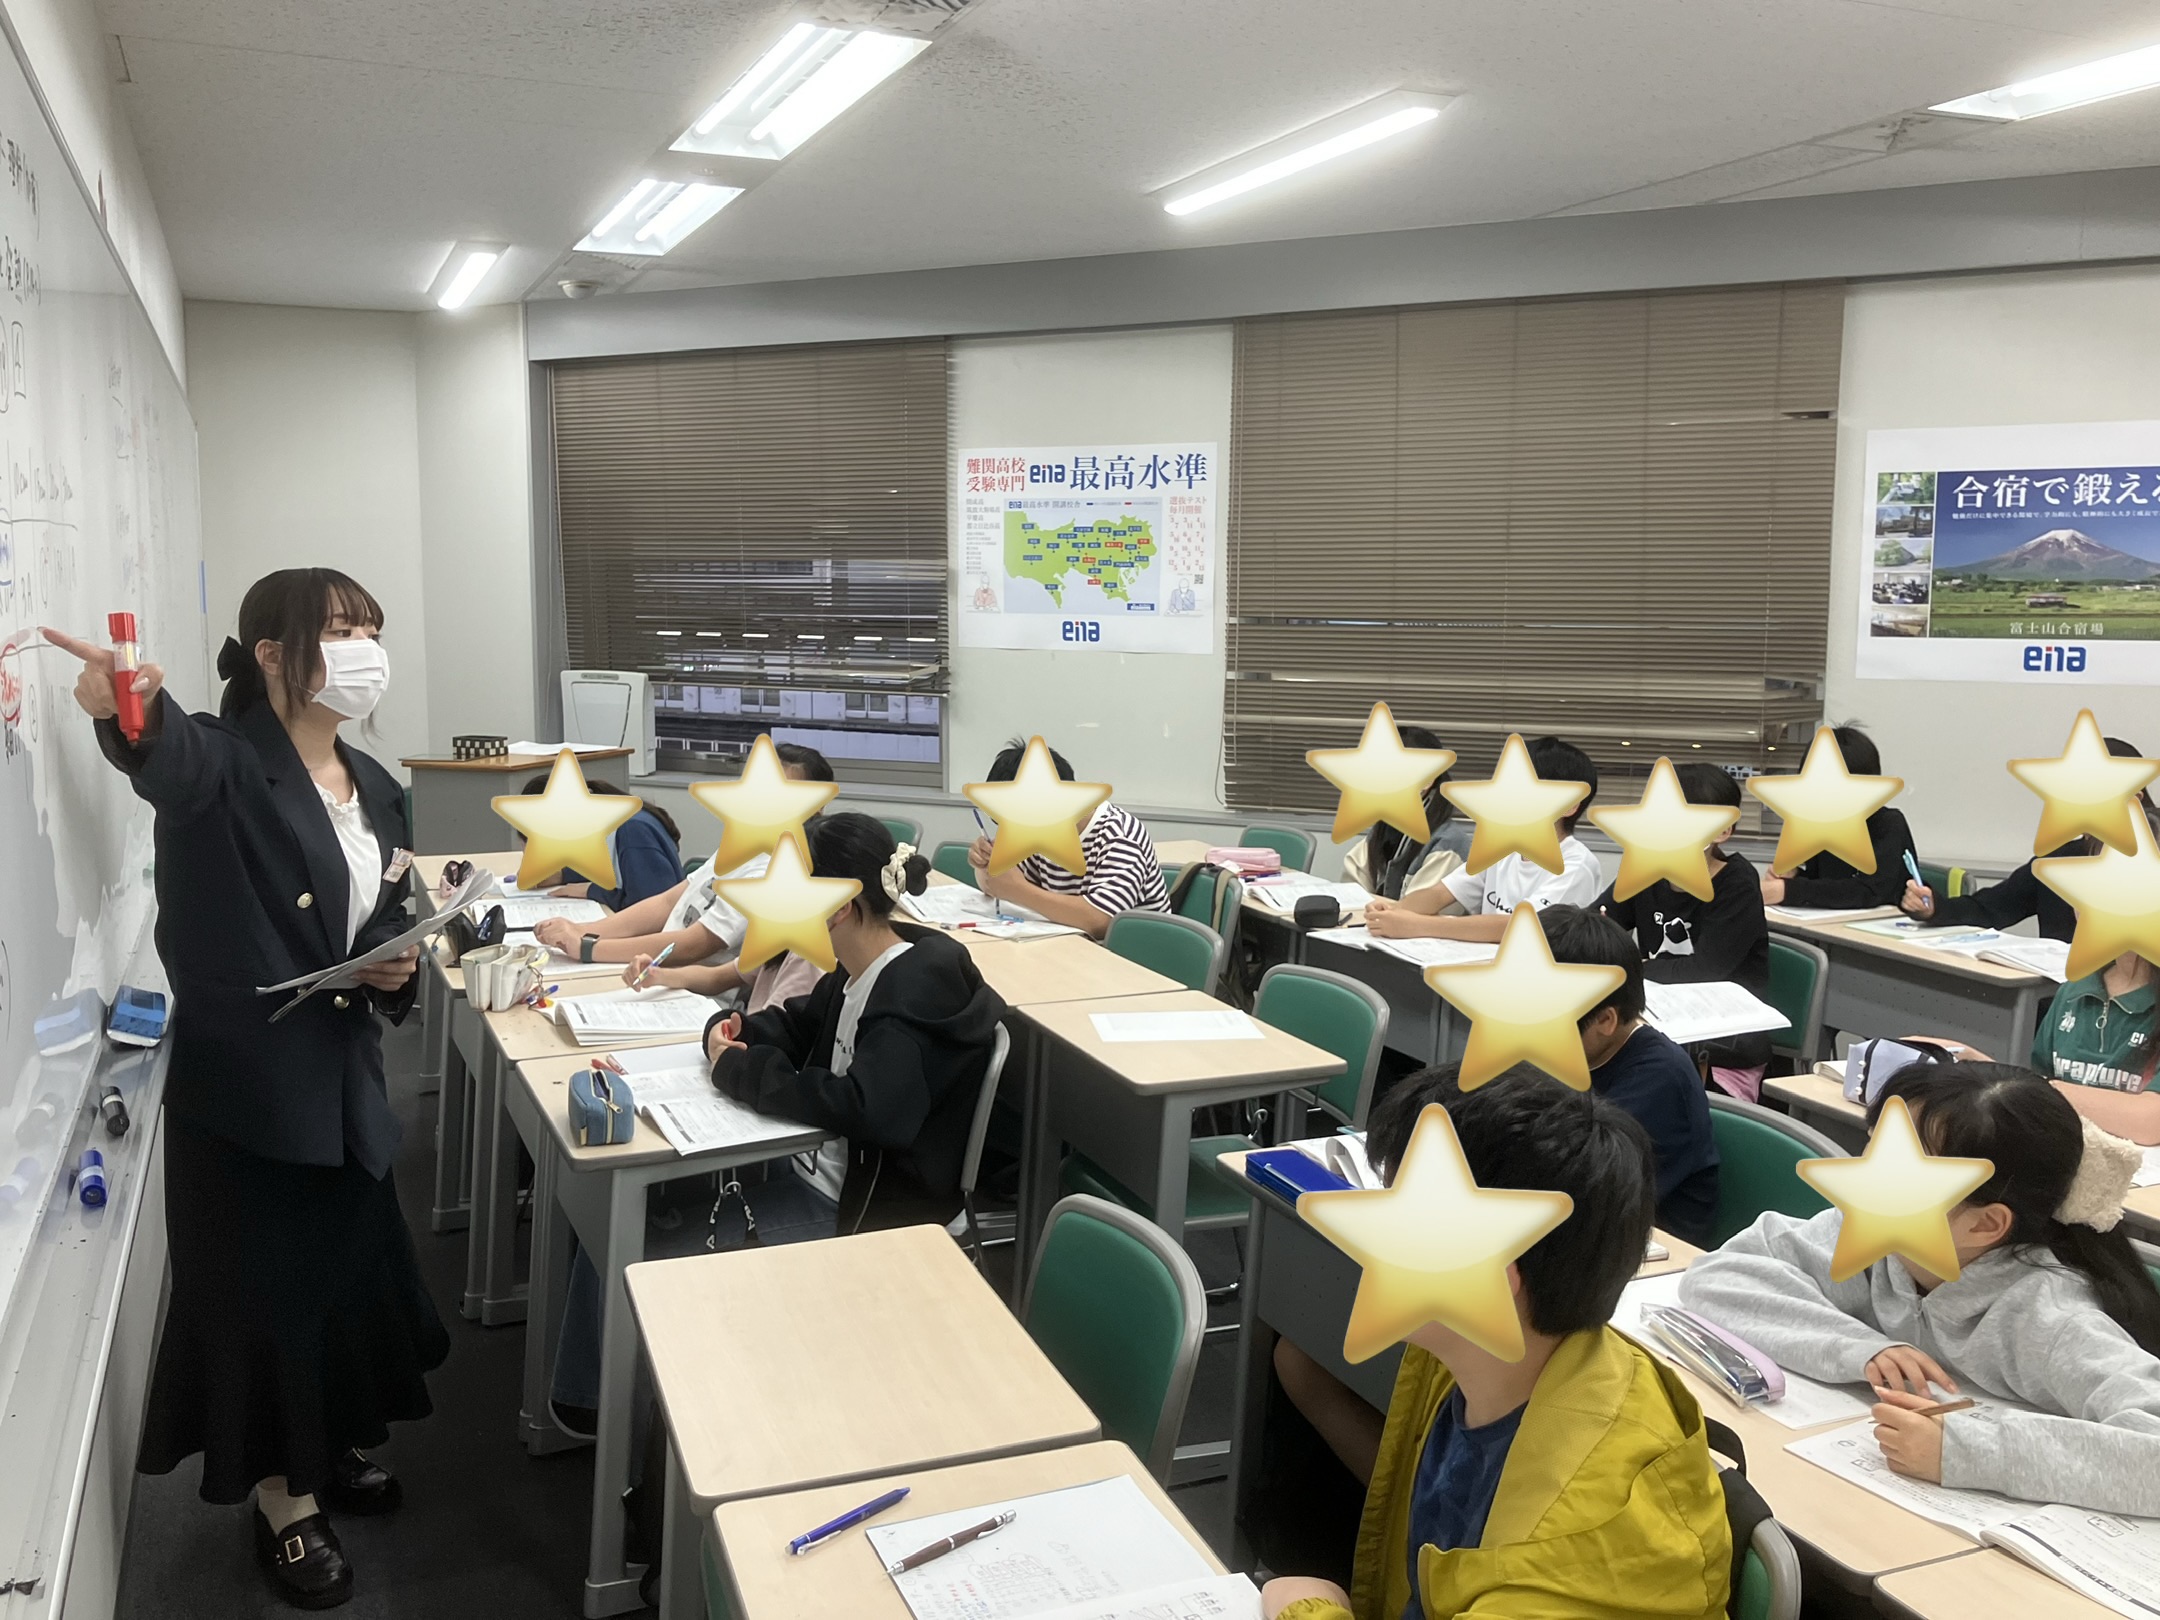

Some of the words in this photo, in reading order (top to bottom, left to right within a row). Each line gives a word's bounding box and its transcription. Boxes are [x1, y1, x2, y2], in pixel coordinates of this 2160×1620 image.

[967, 457, 1025, 475] 難関高校
[1030, 464, 1066, 483] ena
[1070, 453, 1207, 491] 最高水準
[966, 475, 1025, 492] 受験専門
[1952, 472, 2160, 508] 合宿で鍛え
[1062, 621, 1100, 642] ena
[2009, 621, 2105, 636] 富士山合宿場
[2023, 646, 2086, 672] ena
[1487, 891, 1512, 914] Cha
